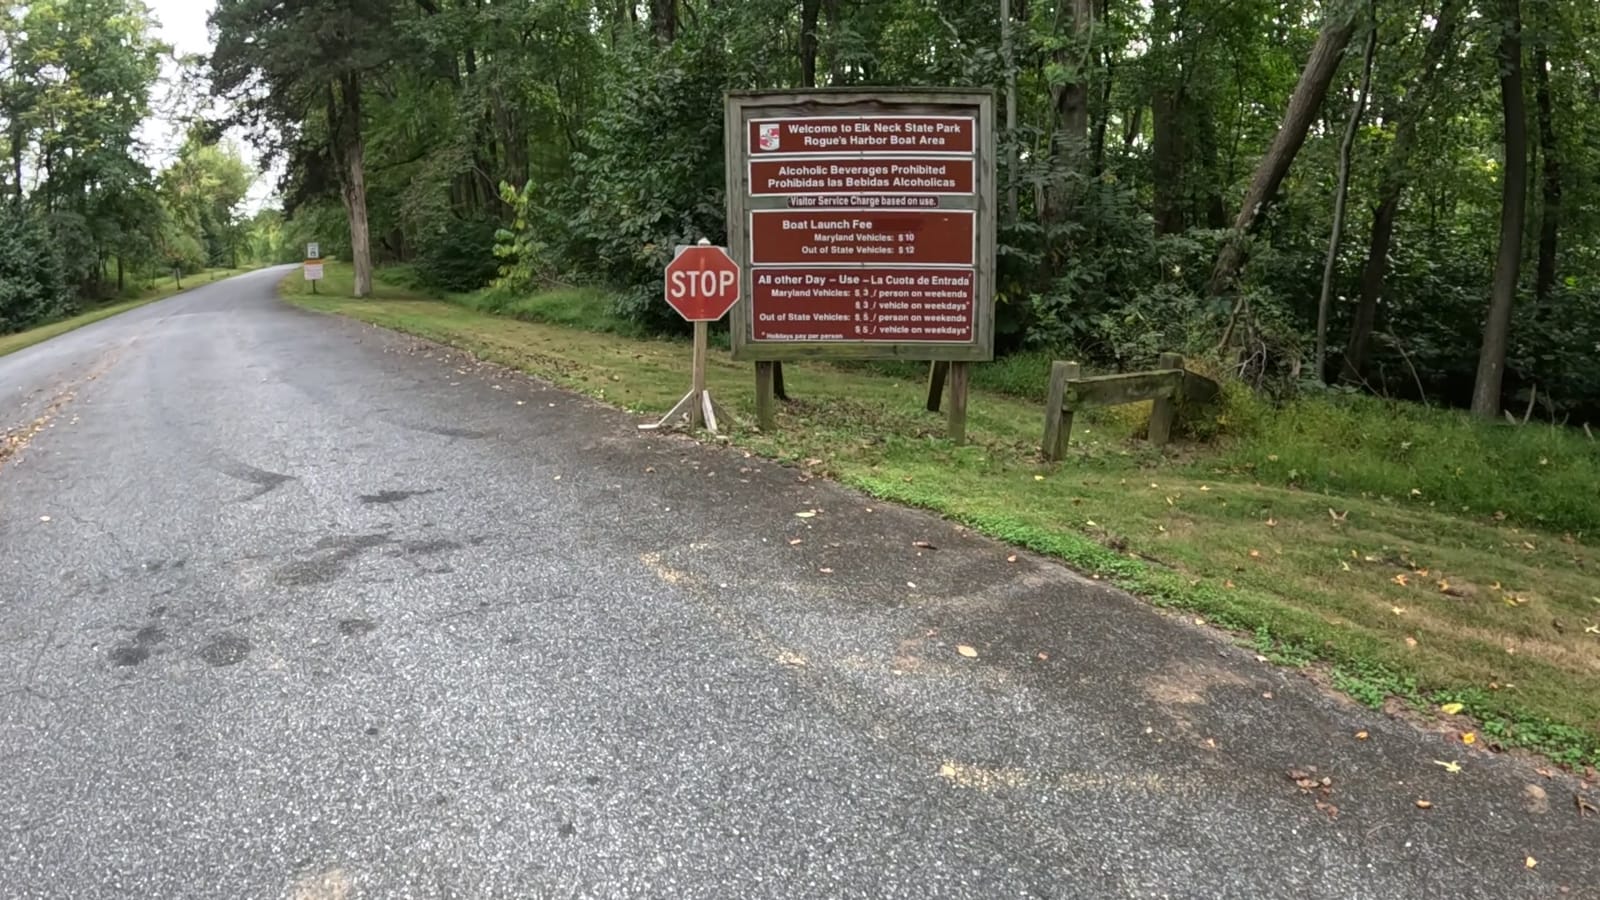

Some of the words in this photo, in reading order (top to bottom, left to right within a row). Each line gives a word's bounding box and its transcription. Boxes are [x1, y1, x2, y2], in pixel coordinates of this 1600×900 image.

[788, 124, 838, 134] Welcome
[840, 124, 852, 133] to
[854, 123, 871, 133] Elk
[873, 123, 902, 133] Neck
[904, 123, 934, 133] State
[936, 123, 961, 133] Park
[804, 136, 847, 147] Rogue's
[849, 135, 888, 145] Harbor
[890, 135, 916, 145] Boat
[919, 135, 945, 145] Area
[778, 166, 828, 176] Alcoholic
[830, 165, 889, 176] Beverages
[890, 164, 946, 175] Prohibited
[767, 178, 825, 189] Prohibidas
[827, 178, 844, 187] las
[845, 177, 890, 187] Bebidas
[892, 177, 956, 187] Alcoholicas
[790, 196, 816, 206] Visitor
[818, 195, 849, 205] Service
[850, 195, 880, 208] Charge
[881, 196, 907, 205] based
[919, 197, 937, 205] use.
[782, 220, 808, 230] Boat
[810, 219, 850, 229] Launch
[852, 219, 873, 229] Fee
[814, 233, 854, 243] Maryland
[856, 233, 894, 242] Vehicles:
[801, 246, 818, 254] Out
[819, 245, 829, 254] of
[830, 245, 854, 254] State
[856, 246, 894, 254] Vehicles:
[671, 270, 735, 298] STOP
[758, 275, 772, 285] All
[774, 275, 803, 285] other
[805, 275, 826, 287] Day
[839, 274, 860, 284] Use
[871, 275, 883, 285] La
[885, 275, 915, 285] Cuota
[917, 275, 930, 285] de
[771, 289, 811, 298] Maryland
[812, 288, 851, 297] Vehicles:
[879, 290, 910, 299] person
[924, 290, 968, 298] weekends
[879, 301, 910, 310] vehicle
[759, 313, 775, 321] Out
[776, 313, 787, 321] of
[788, 313, 811, 321] State
[812, 313, 851, 321] Vehicles:
[879, 314, 910, 323] person
[924, 314, 967, 322] weekends
[879, 325, 910, 334] vehicle
